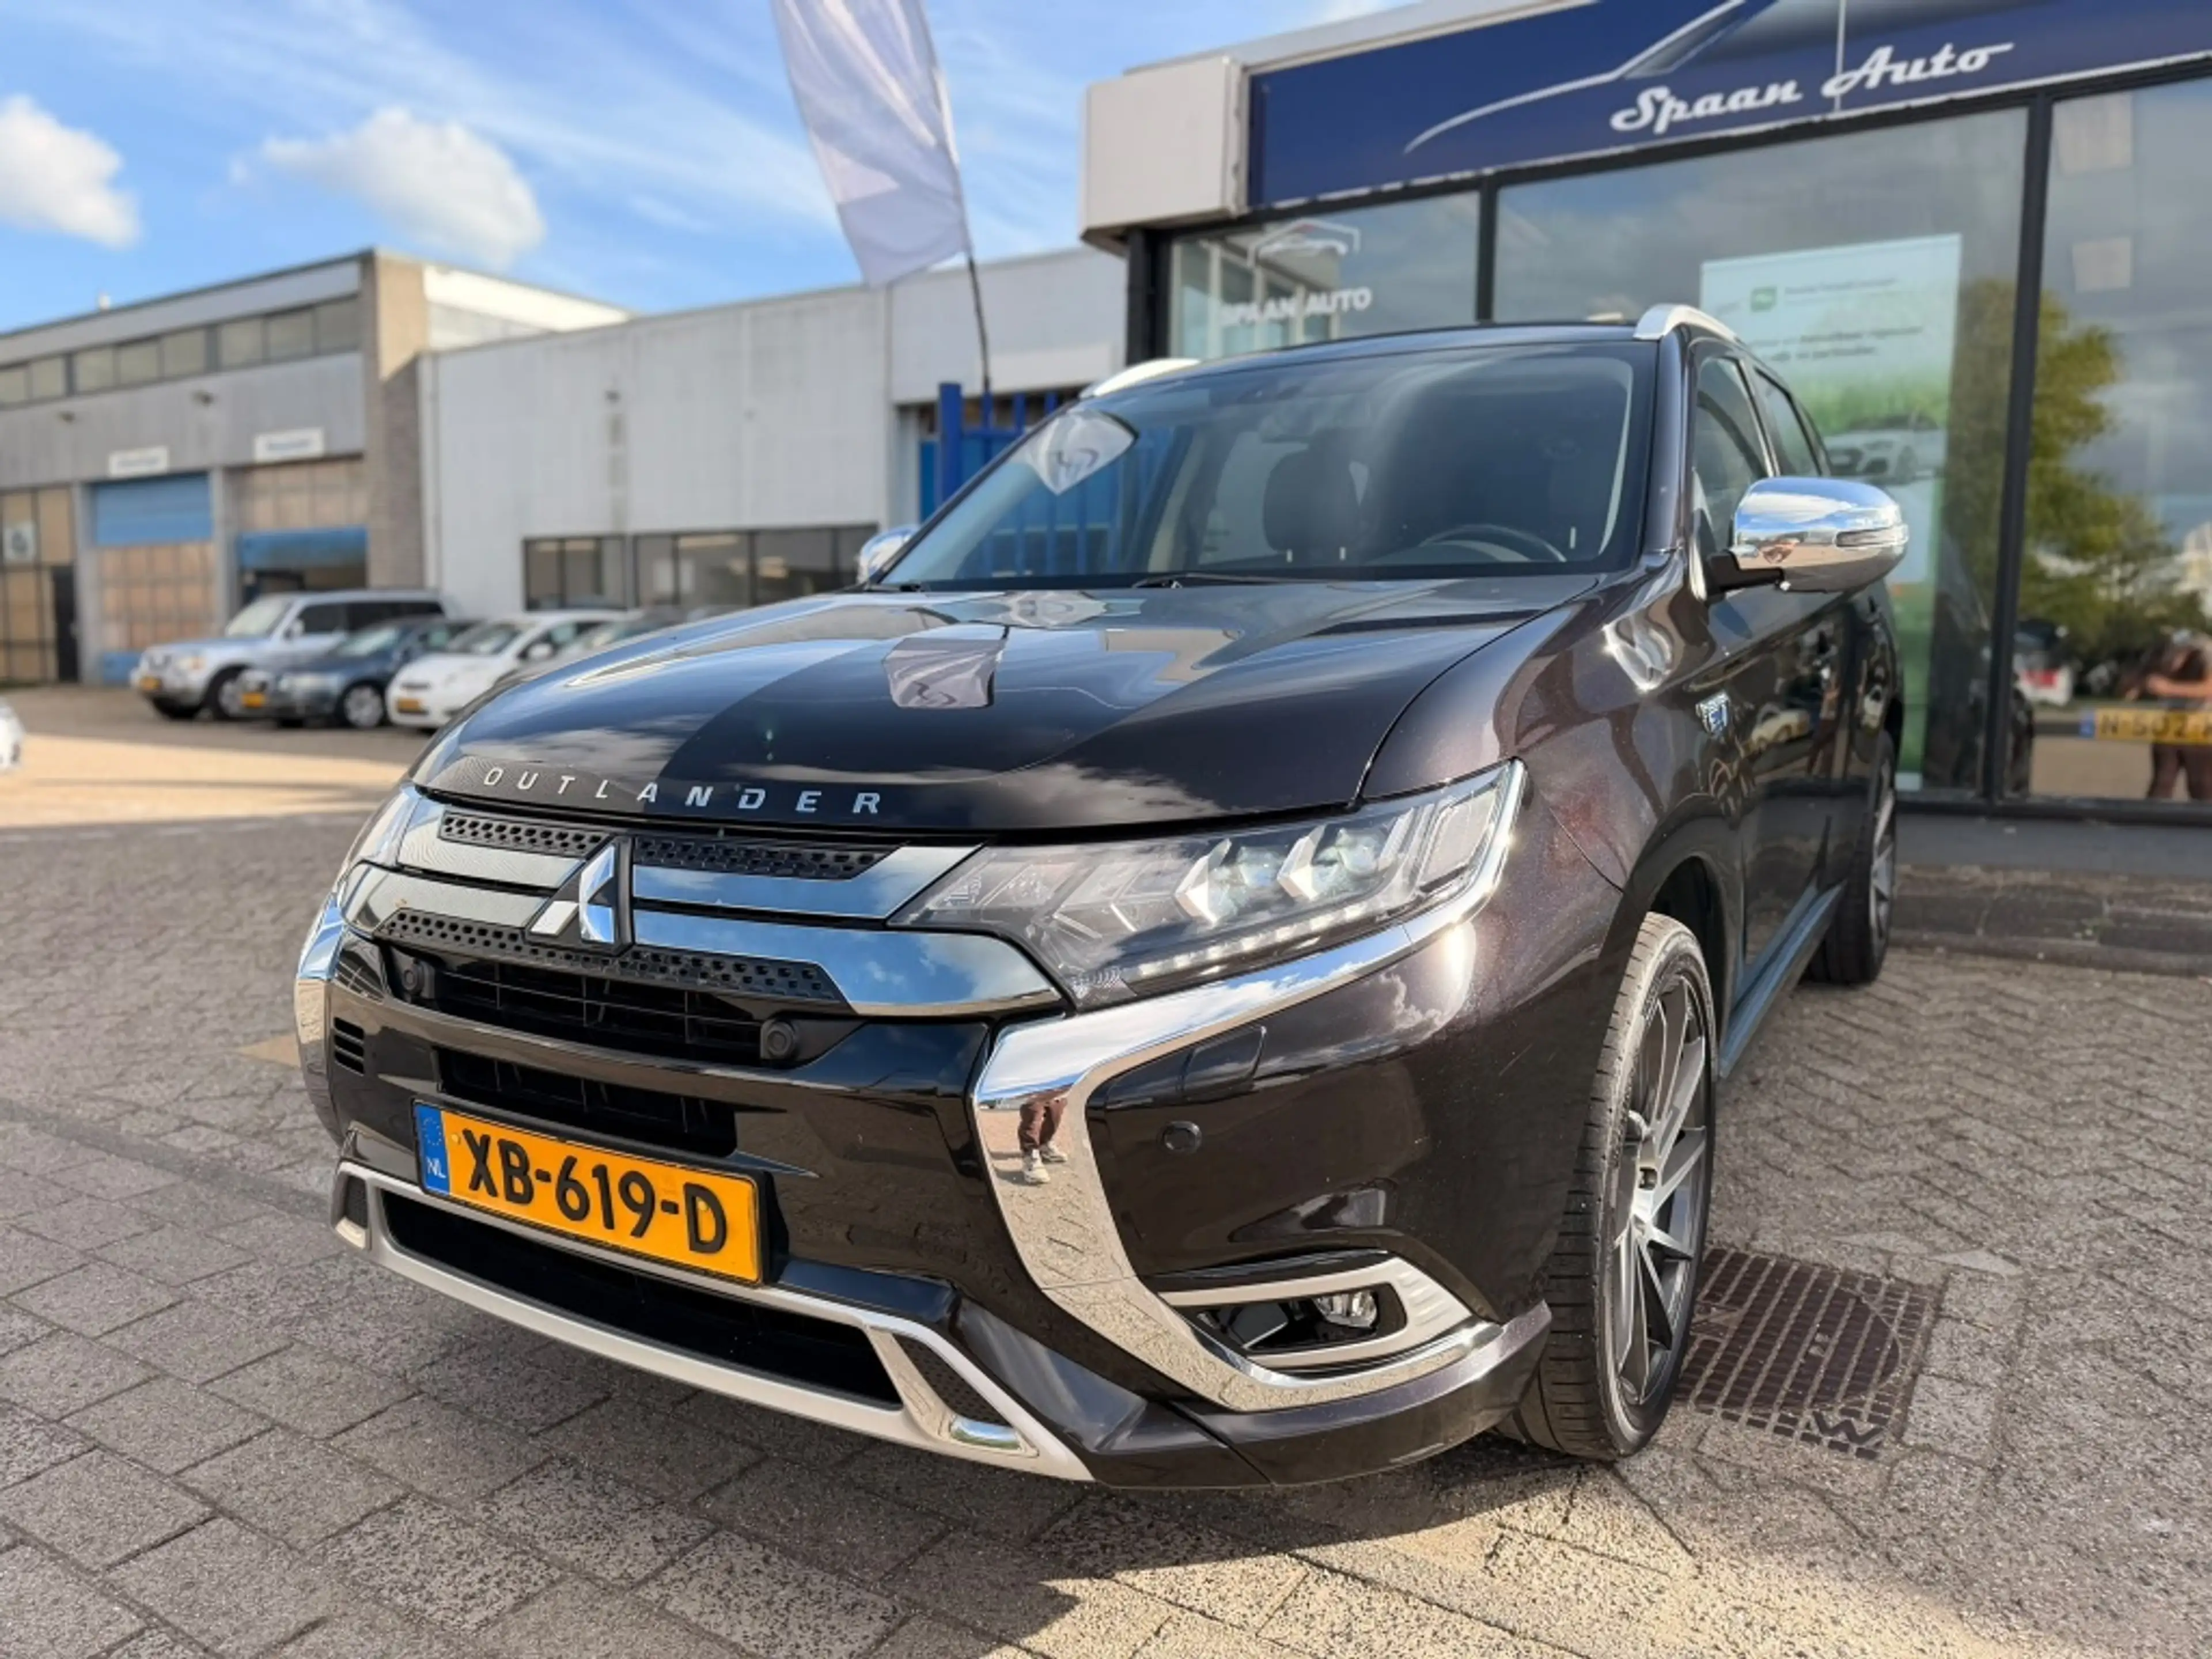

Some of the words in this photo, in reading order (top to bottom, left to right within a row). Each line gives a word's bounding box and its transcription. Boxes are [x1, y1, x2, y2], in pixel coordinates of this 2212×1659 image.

[1610, 79, 1803, 135] Spaan
[1821, 43, 2014, 98] Auto
[1305, 286, 1372, 316] AUTO
[483, 767, 881, 815] OUTLANDER
[426, 1157, 448, 1179] NL
[463, 1128, 728, 1255] XB-619-D
